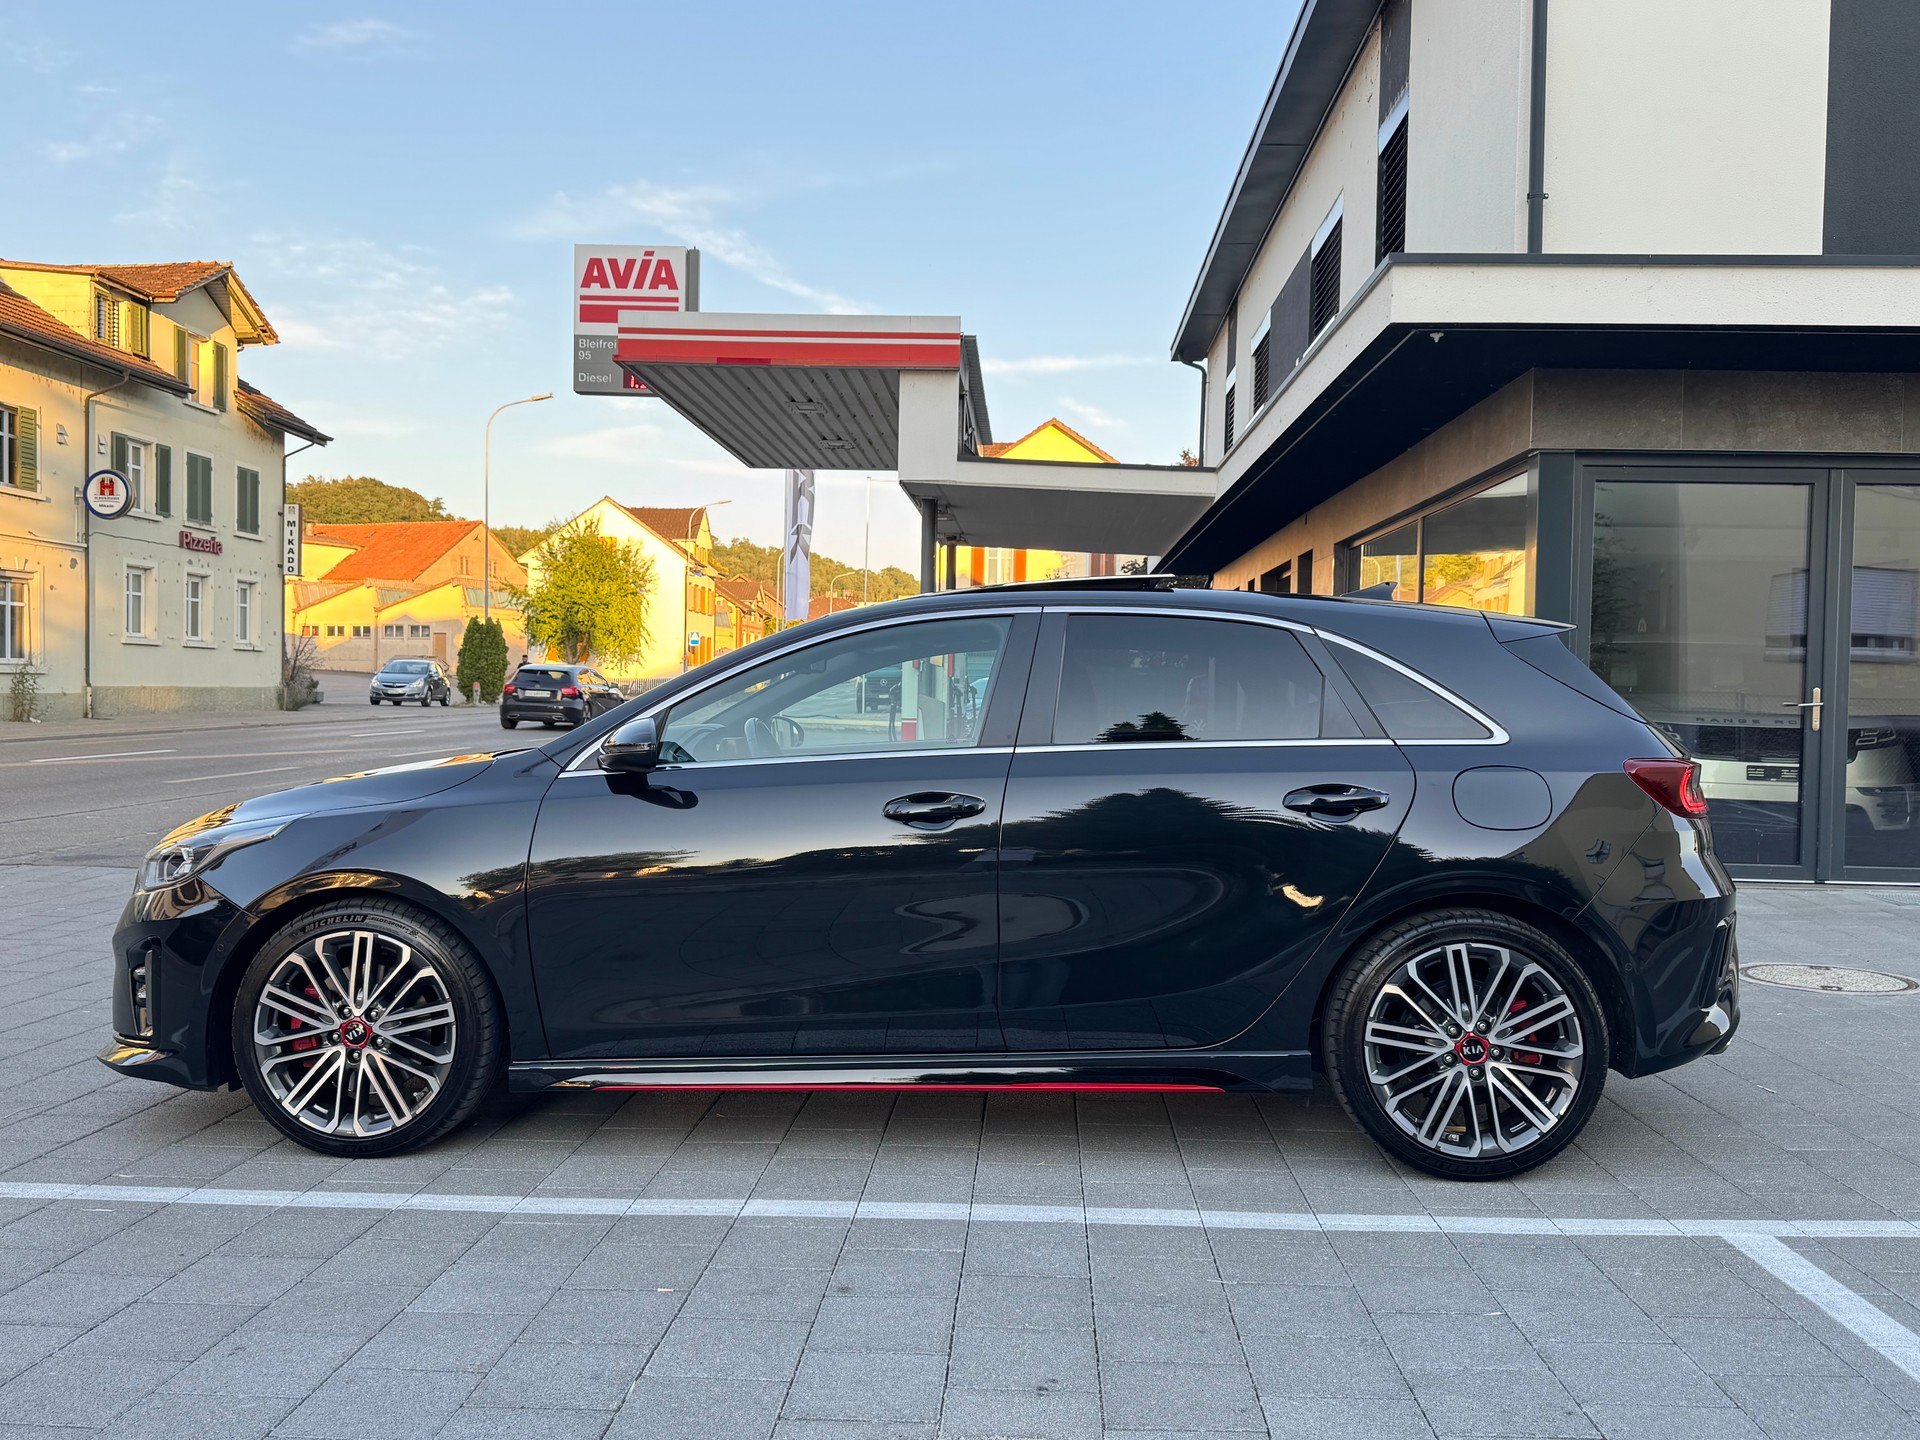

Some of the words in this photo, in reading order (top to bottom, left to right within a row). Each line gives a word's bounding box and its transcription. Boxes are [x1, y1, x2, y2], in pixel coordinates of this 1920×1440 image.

[578, 338, 617, 349] Bleifrei
[578, 350, 592, 360] 95
[578, 372, 612, 383] Diesel
[182, 531, 223, 554] Pizzeria
[287, 520, 296, 573] MIKADO
[305, 914, 364, 933] MICHELIN
[345, 1024, 365, 1040] KIA
[1463, 1045, 1484, 1055] KIA
